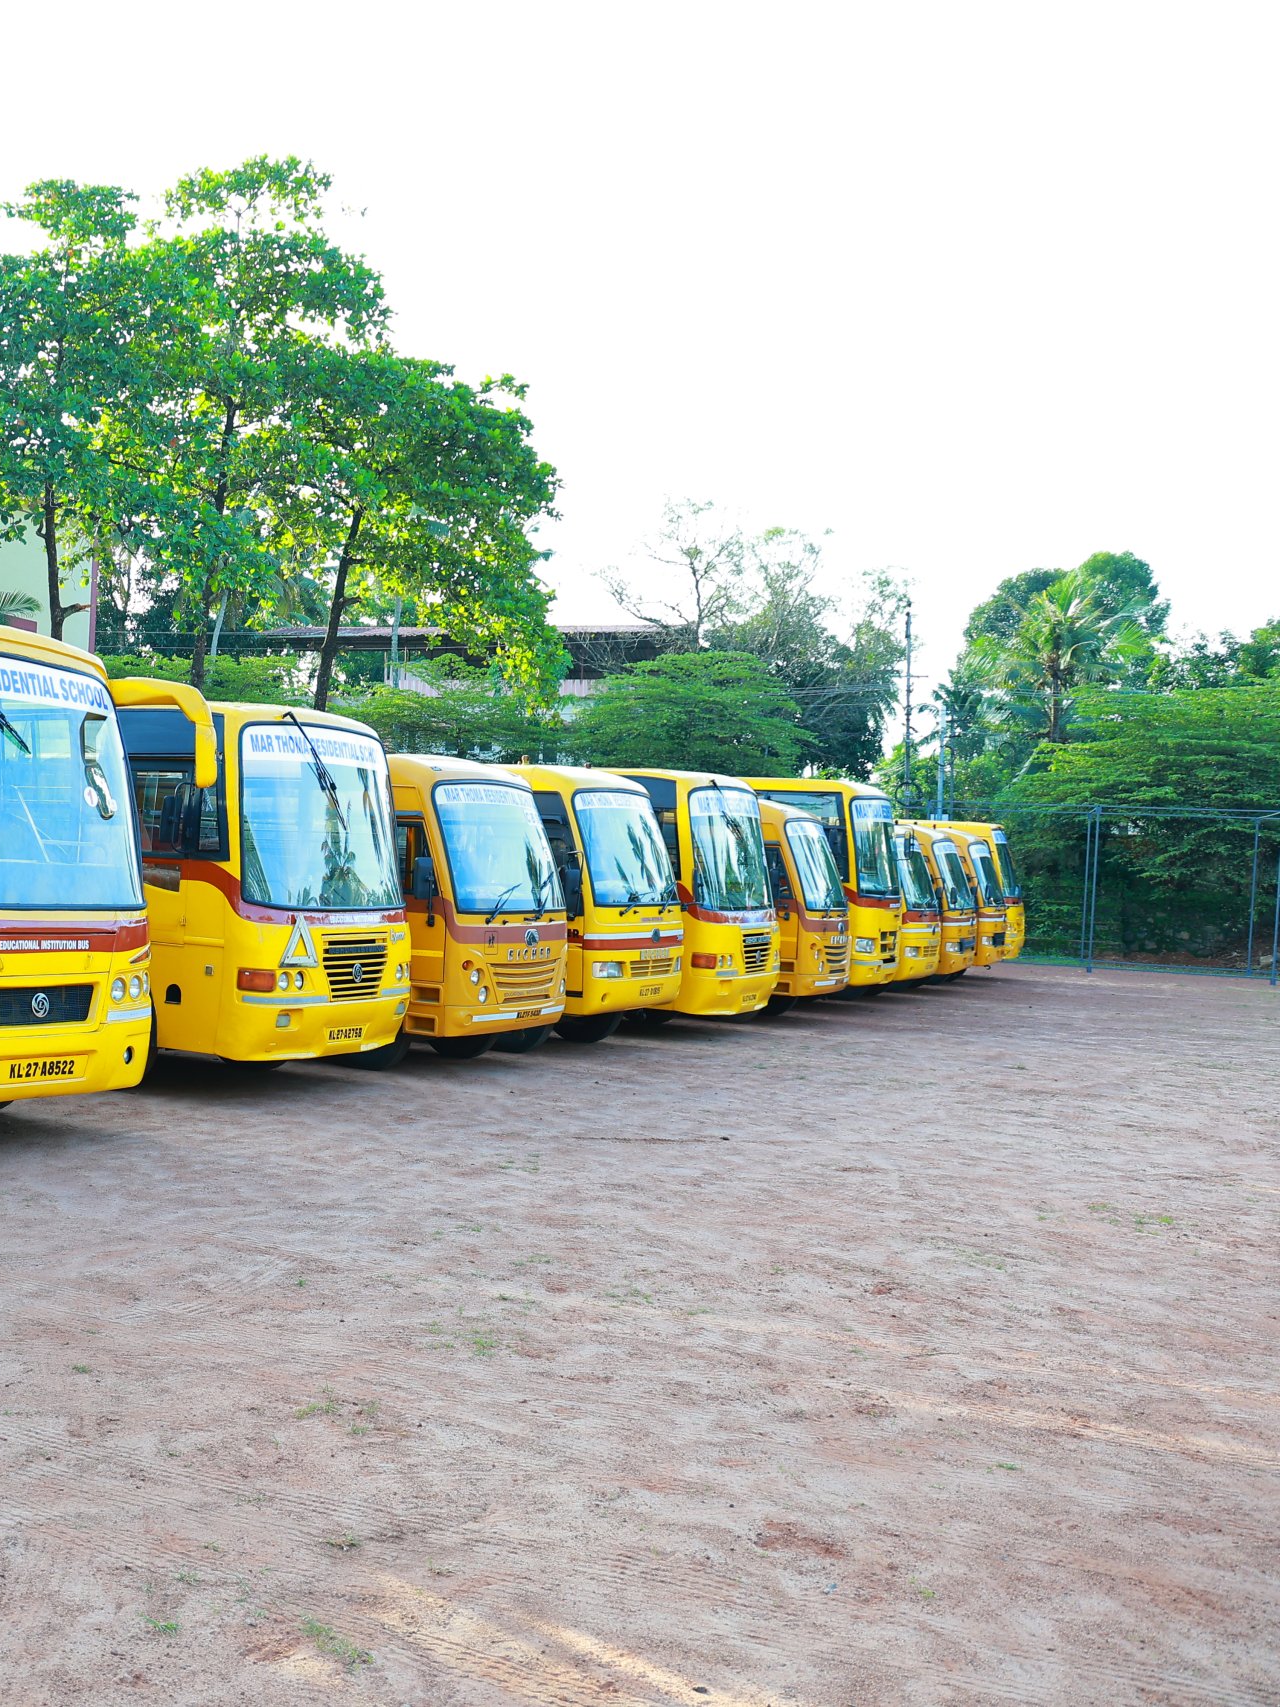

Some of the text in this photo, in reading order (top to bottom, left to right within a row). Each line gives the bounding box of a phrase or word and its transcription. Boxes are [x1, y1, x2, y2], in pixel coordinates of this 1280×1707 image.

[60, 677, 109, 710] SCHOOL
[250, 734, 275, 753] MAR
[275, 735, 309, 753] THOMA
[310, 738, 360, 761] RESIDENTIAL
[443, 787, 462, 802] MAR
[40, 939, 77, 950] INSTITUTION
[77, 939, 90, 950] BUS
[507, 946, 551, 961] EICHER
